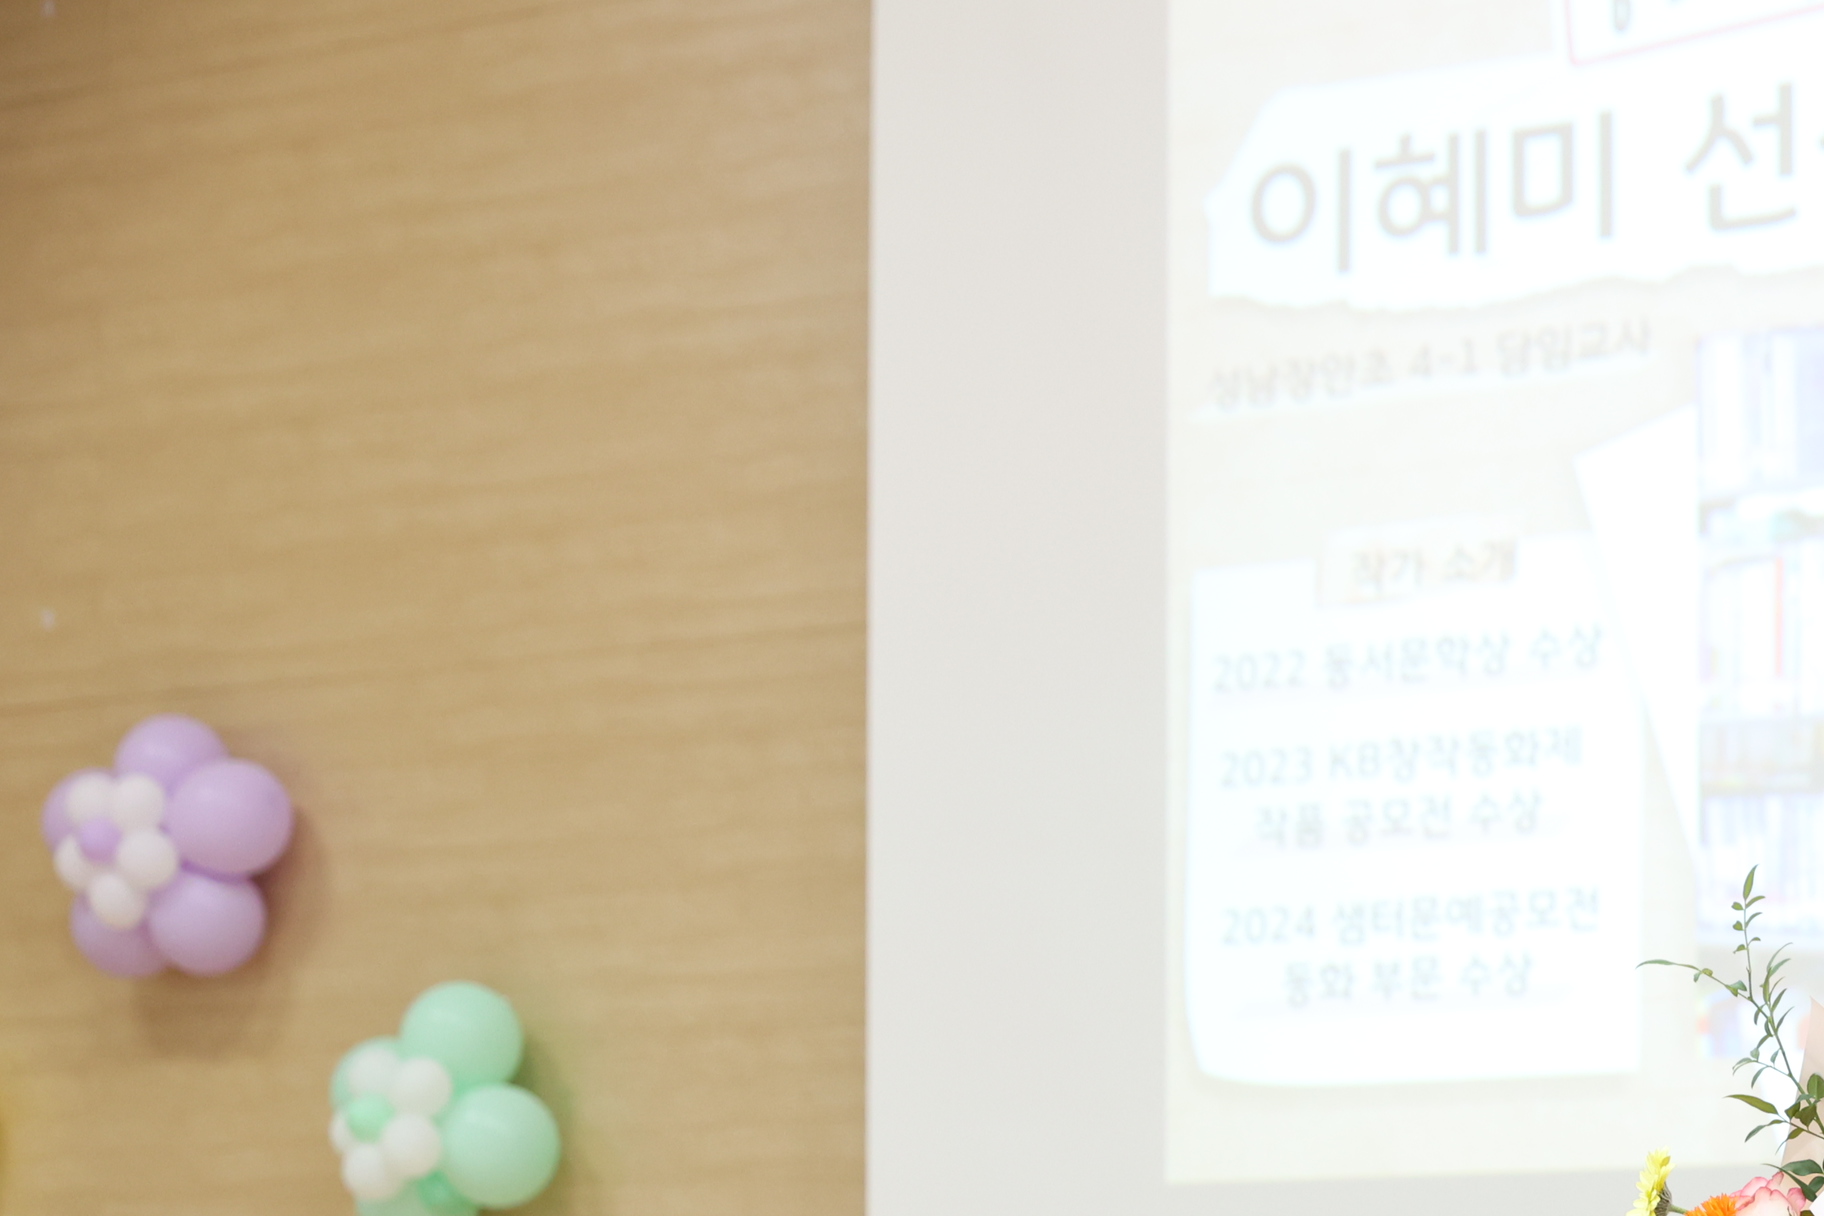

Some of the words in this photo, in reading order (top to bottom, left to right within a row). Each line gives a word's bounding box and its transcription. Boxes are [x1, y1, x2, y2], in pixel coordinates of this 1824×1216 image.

[1250, 109, 1614, 274] 이혜미
[1406, 336, 1480, 379] 4-1
[1496, 316, 1653, 378] 담임교사
[1351, 547, 1425, 596] 작가
[1441, 540, 1516, 584] 소개
[1211, 649, 1306, 695] 2022
[1324, 629, 1511, 690] 동서문학상
[1529, 621, 1603, 671] 수상
[1220, 744, 1314, 790] 2023
[1328, 724, 1584, 785] KB창작동화제
[1255, 801, 1324, 850] 작품
[1344, 794, 1453, 846] 공모전
[1469, 787, 1542, 836] 수상
[1220, 903, 1316, 947] 2024
[1332, 884, 1600, 948] 샘터문예공모전
[1284, 960, 1356, 1011] 동화
[1372, 953, 1442, 1002] 부문
[1461, 949, 1534, 998] 수상
